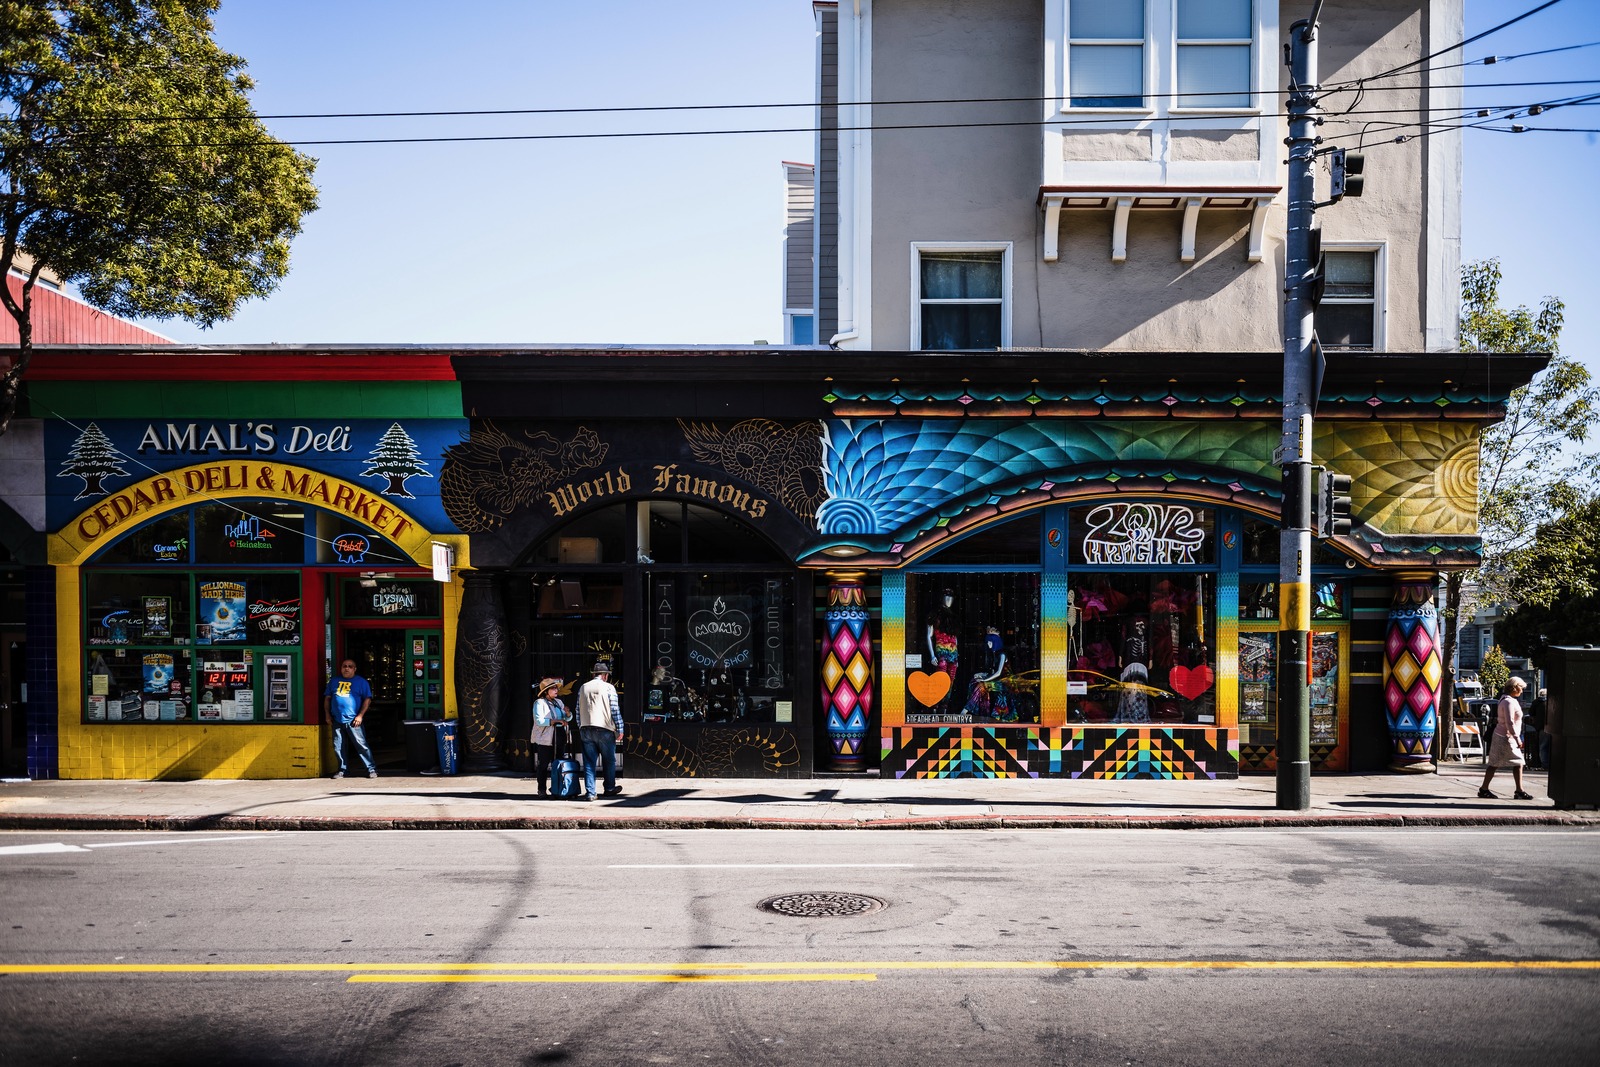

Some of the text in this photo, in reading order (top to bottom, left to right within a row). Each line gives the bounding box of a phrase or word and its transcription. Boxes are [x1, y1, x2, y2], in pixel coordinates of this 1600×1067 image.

[137, 423, 353, 454] AMAL'S Deli
[544, 463, 769, 519] World Famous
[77, 465, 415, 542] CEDAR DELI & MARKET
[153, 543, 178, 553] Corona
[236, 540, 273, 549] Heineken
[337, 539, 365, 552] Pabst
[200, 581, 246, 591] MILLIONAIRE
[201, 590, 246, 599] MADE HERE
[373, 593, 414, 608] ELYSIAN
[248, 603, 300, 614] Budweiser
[259, 619, 293, 630] GIANTS
[657, 584, 673, 683] TATTOOS
[766, 580, 782, 689] PIERCING
[690, 649, 750, 667] BODY SHOP
[230, 673, 247, 683] 144
[910, 714, 969, 723] DEADHEAD COUNTRY
